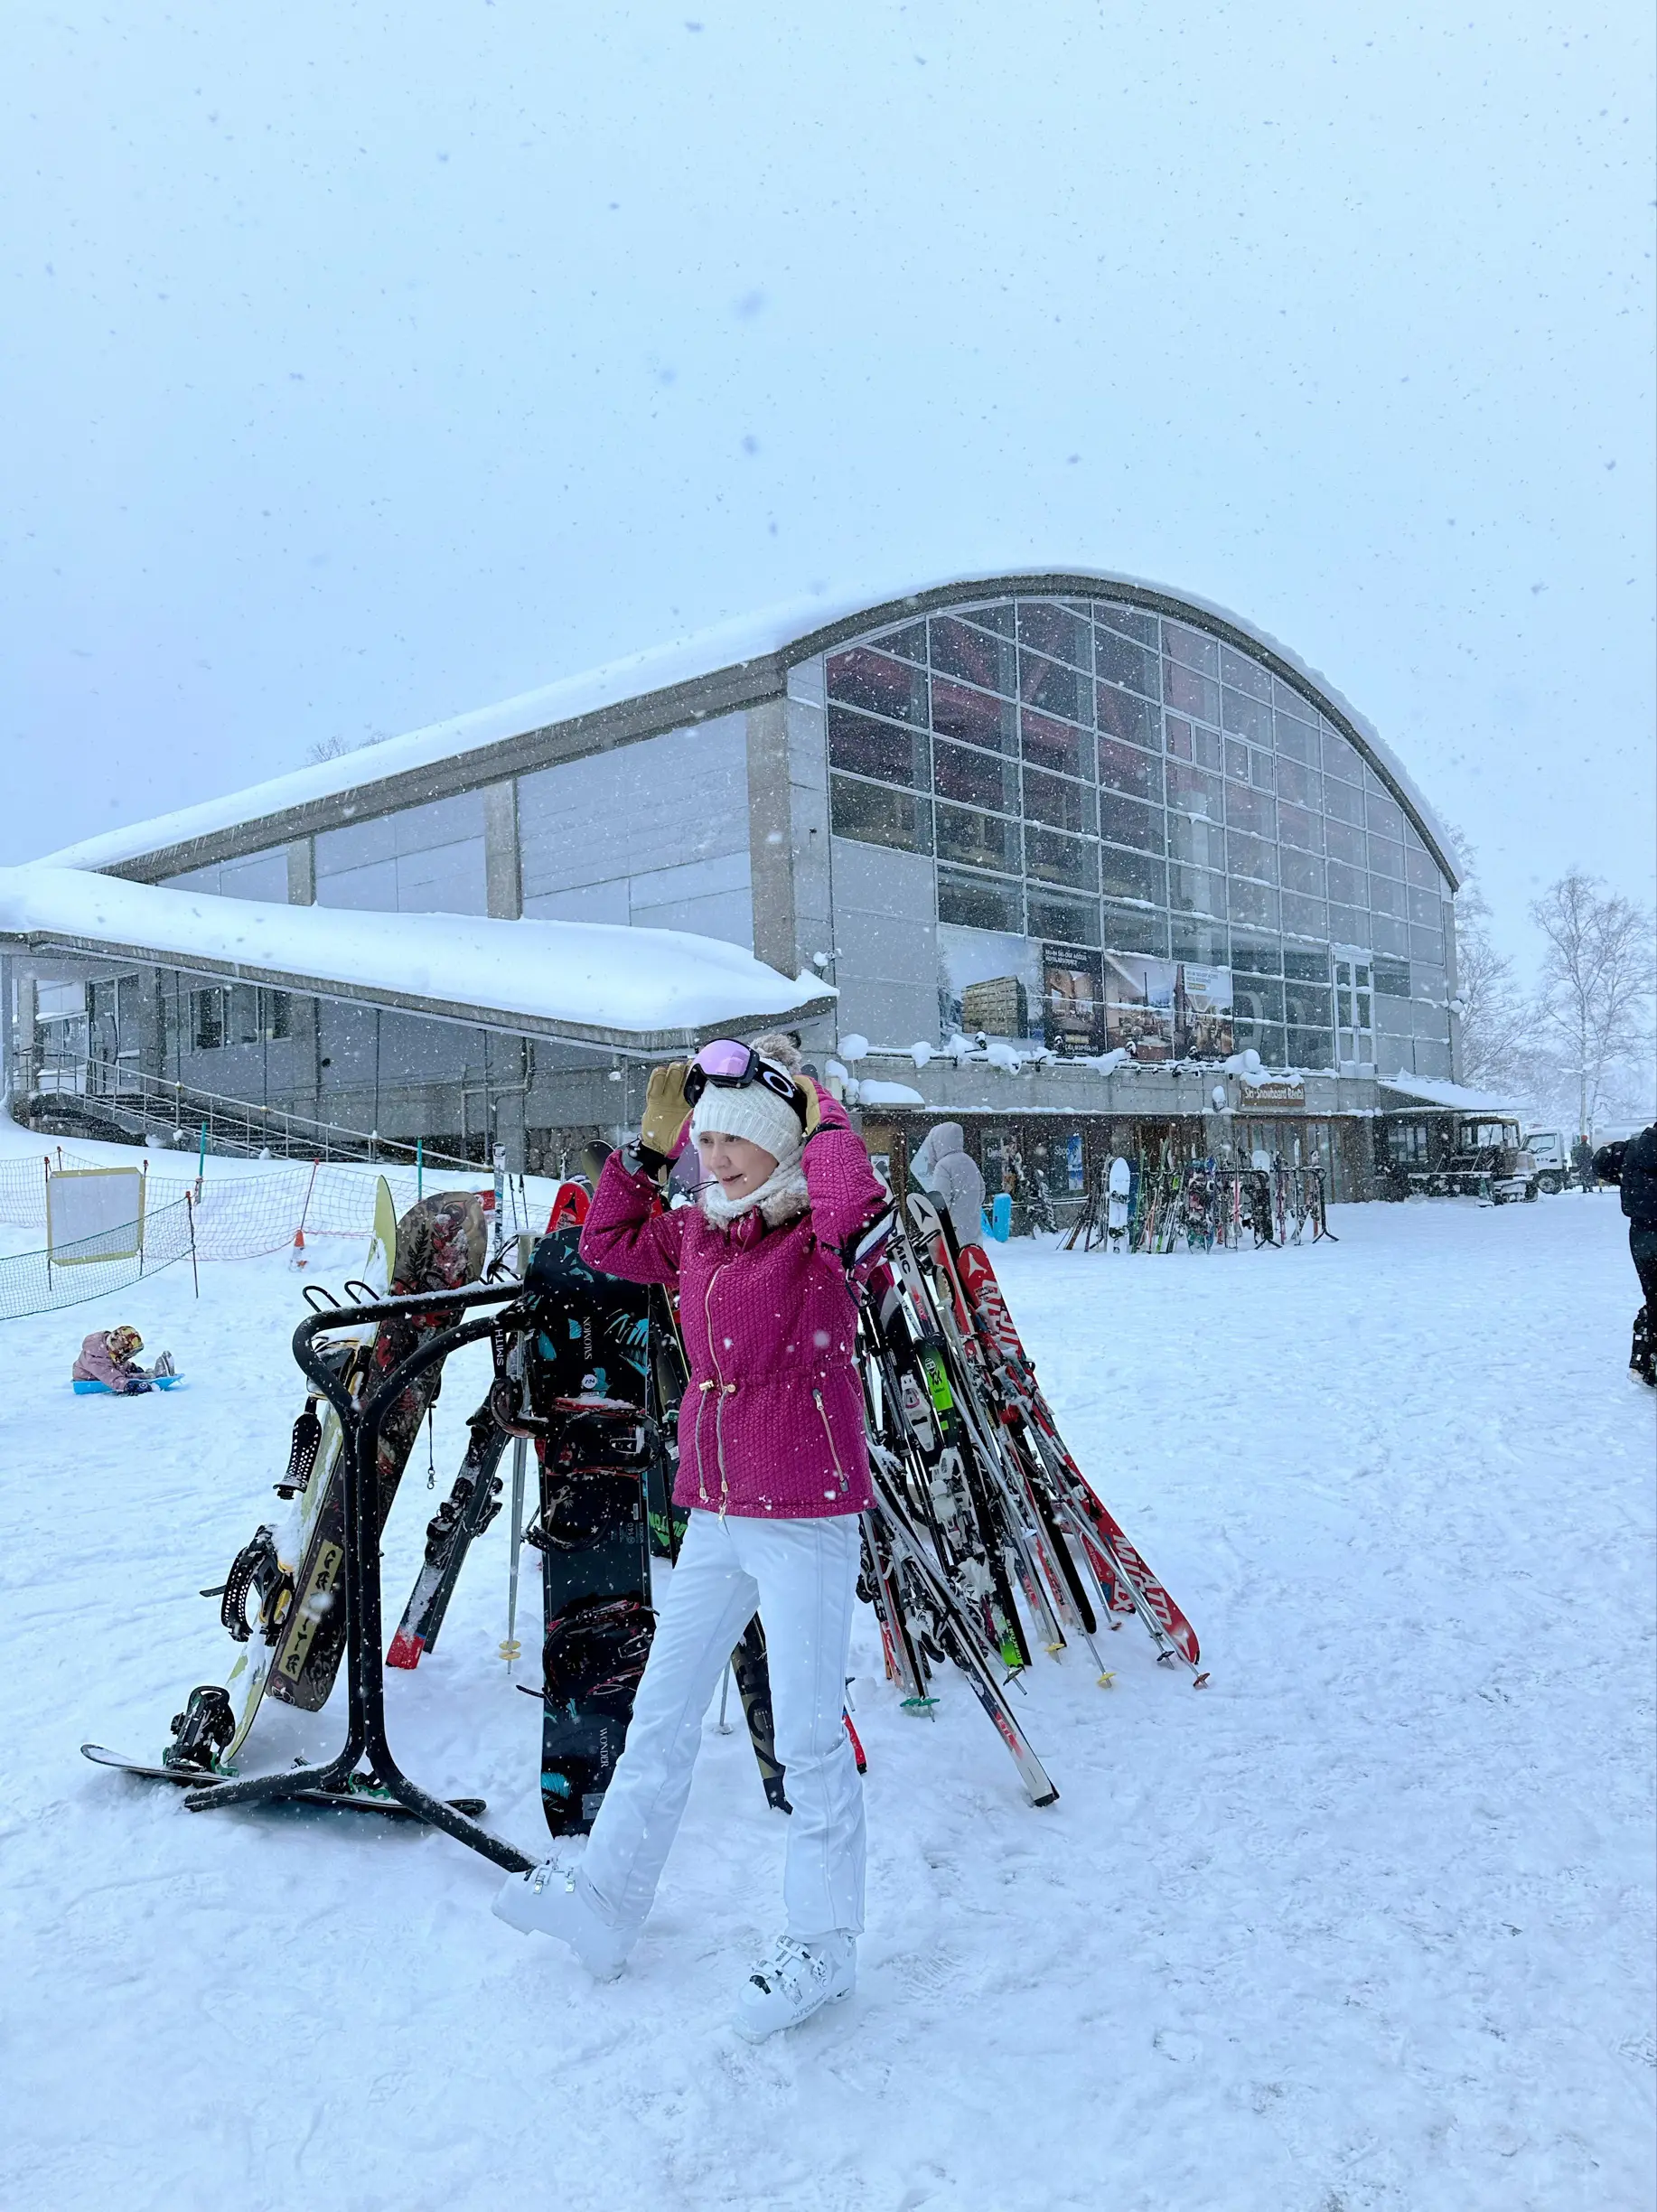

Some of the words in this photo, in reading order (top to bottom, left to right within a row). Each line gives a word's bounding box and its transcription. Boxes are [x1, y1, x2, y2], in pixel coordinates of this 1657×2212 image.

[1054, 1145, 1070, 1156] Shop
[583, 1317, 592, 1360] SALOMON
[600, 1727, 608, 1767] WONDER
